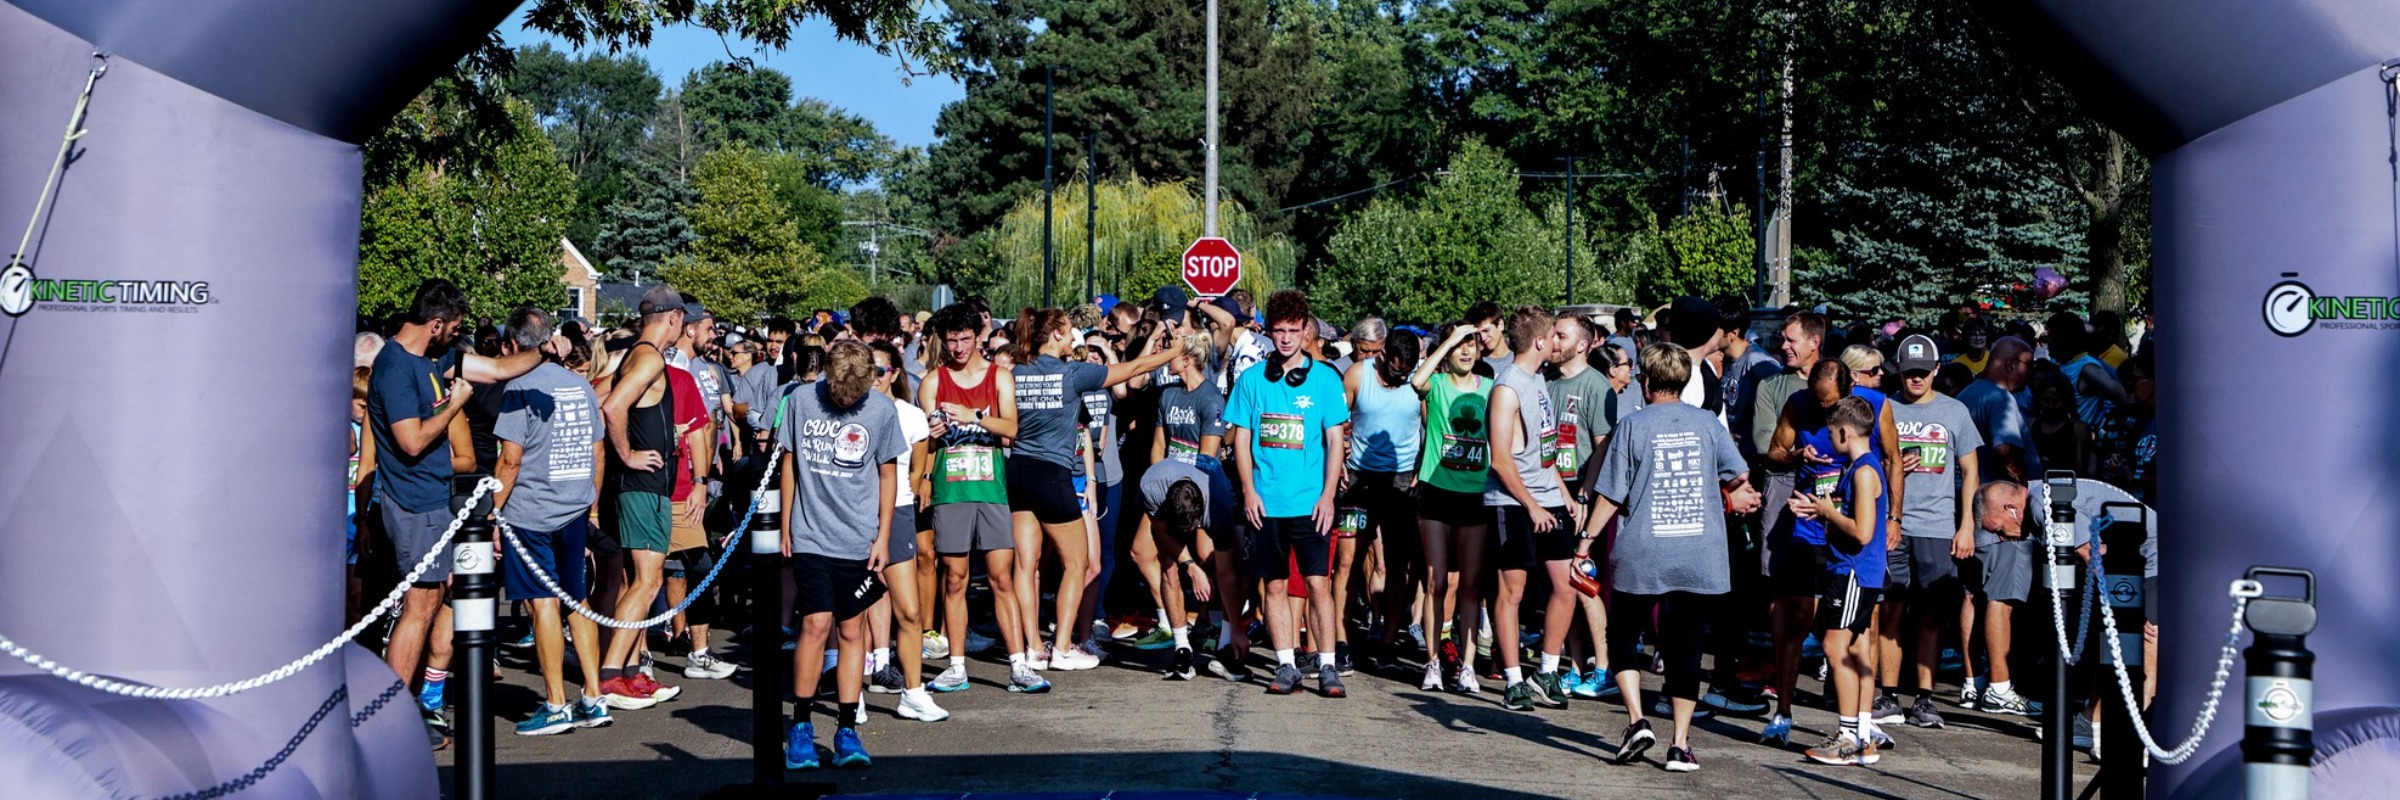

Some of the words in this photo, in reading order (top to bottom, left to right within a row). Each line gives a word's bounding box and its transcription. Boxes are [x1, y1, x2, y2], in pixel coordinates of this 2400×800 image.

[1187, 255, 1237, 278] STOP
[29, 279, 115, 302] KINETIC
[117, 280, 209, 304] TIMING
[38, 304, 88, 313] PROFESSIONAL
[90, 305, 117, 313] SPORTS
[119, 305, 146, 313] TIMING
[2308, 296, 2400, 319] KINETIC
[2320, 322, 2377, 330] PROFESSIONAL
[2380, 322, 2400, 330] SPOR
[1040, 395, 1064, 403] ONLY
[803, 418, 841, 438] CWC
[1278, 422, 1304, 441] 378
[1896, 420, 1923, 437] WC
[812, 438, 835, 453] RUN
[802, 449, 830, 465] WALK
[1467, 446, 1484, 463] 44
[1556, 452, 1572, 468] 46
[1922, 446, 1947, 464] 172
[1346, 513, 1367, 529] 146
